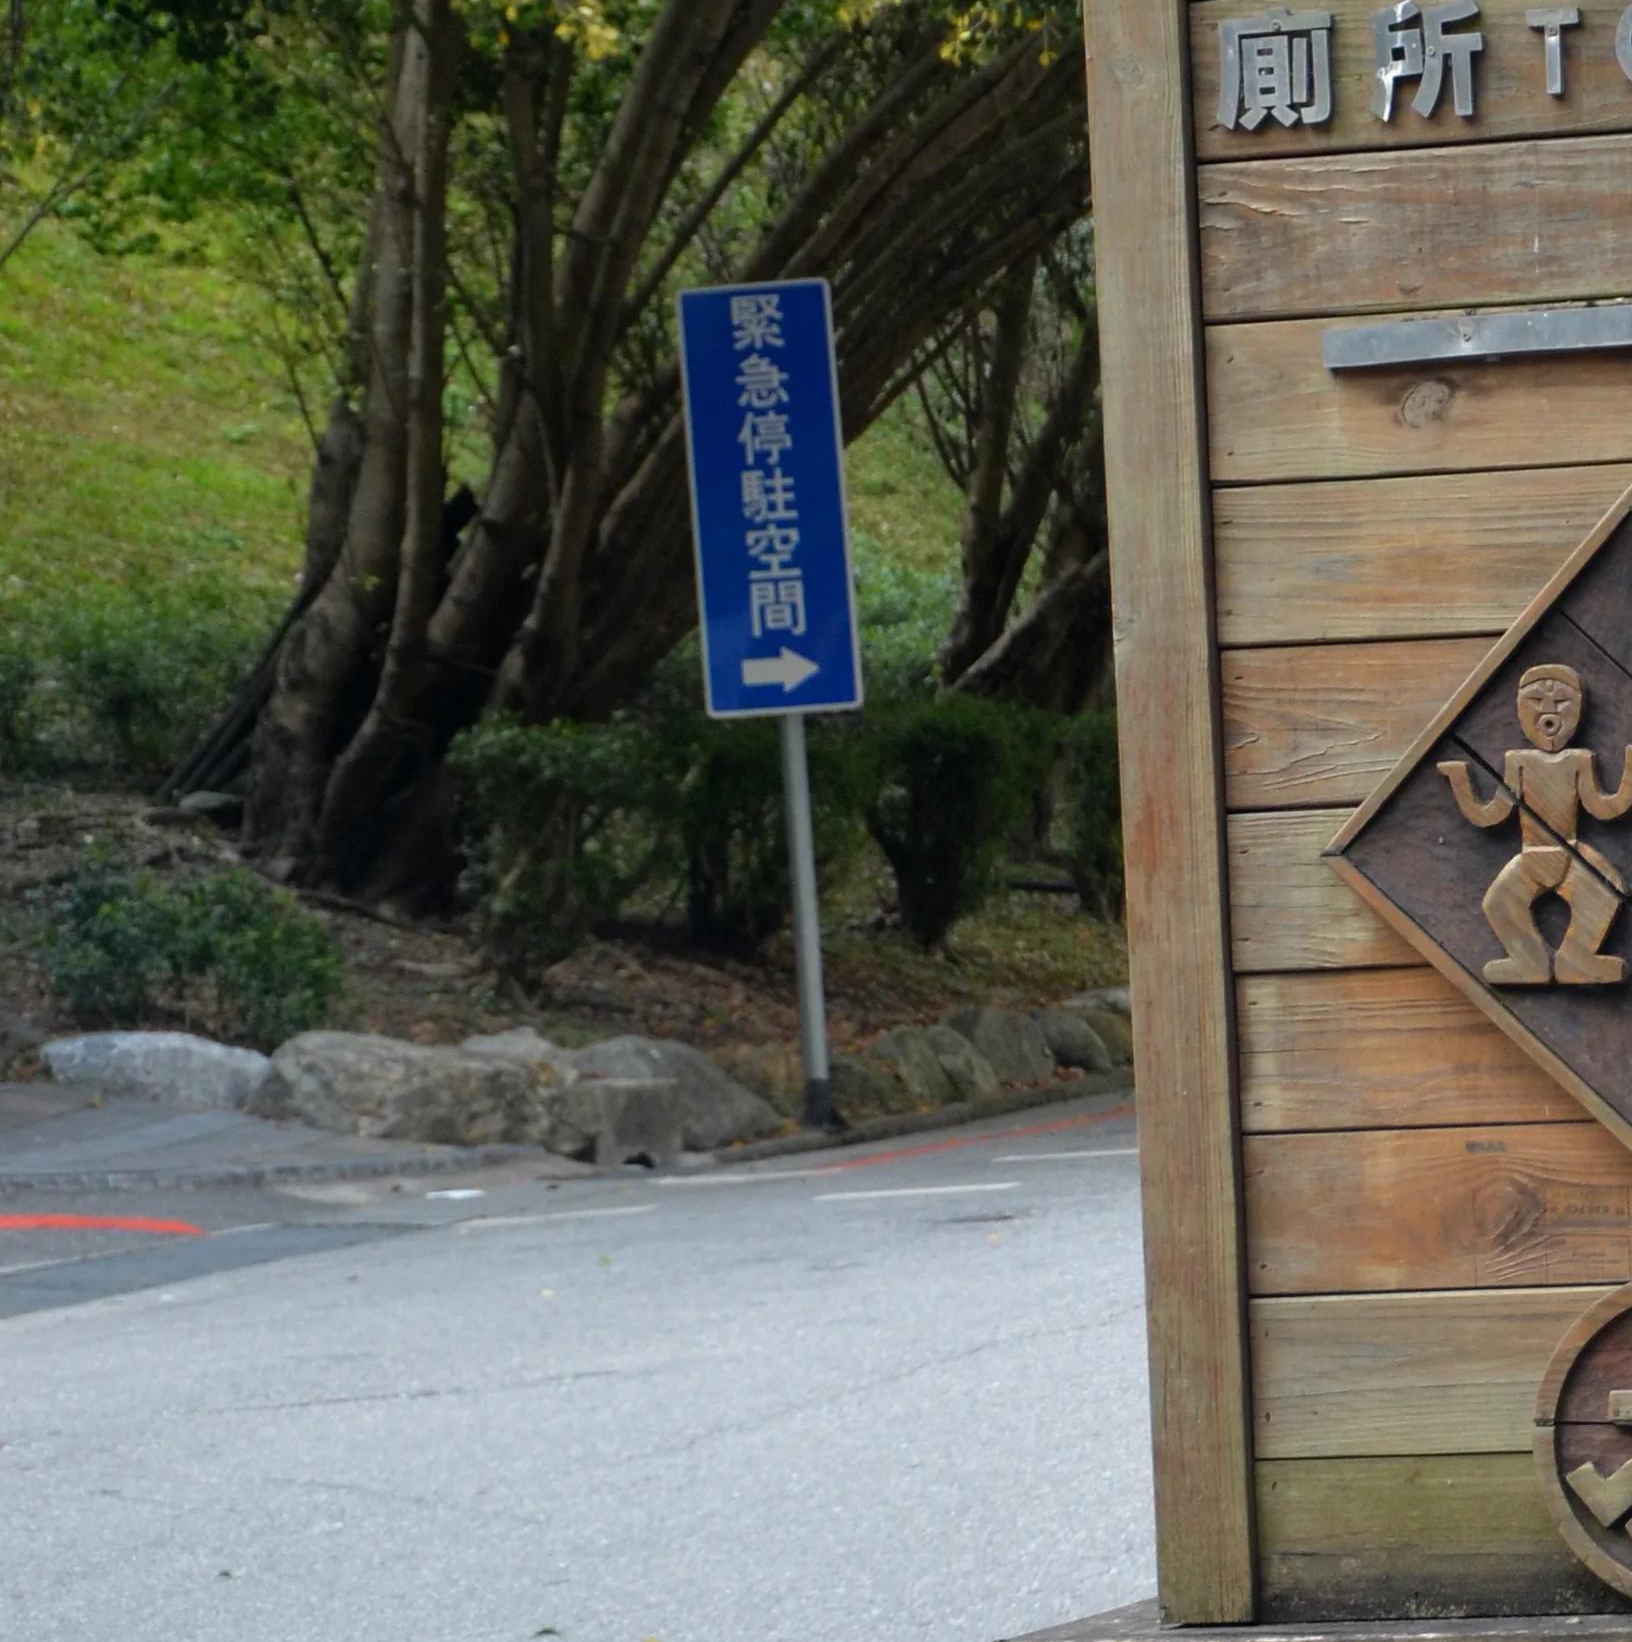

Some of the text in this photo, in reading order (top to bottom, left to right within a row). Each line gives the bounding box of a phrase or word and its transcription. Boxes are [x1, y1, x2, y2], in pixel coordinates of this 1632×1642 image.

[729, 293, 808, 639] 緊急停駐空間
